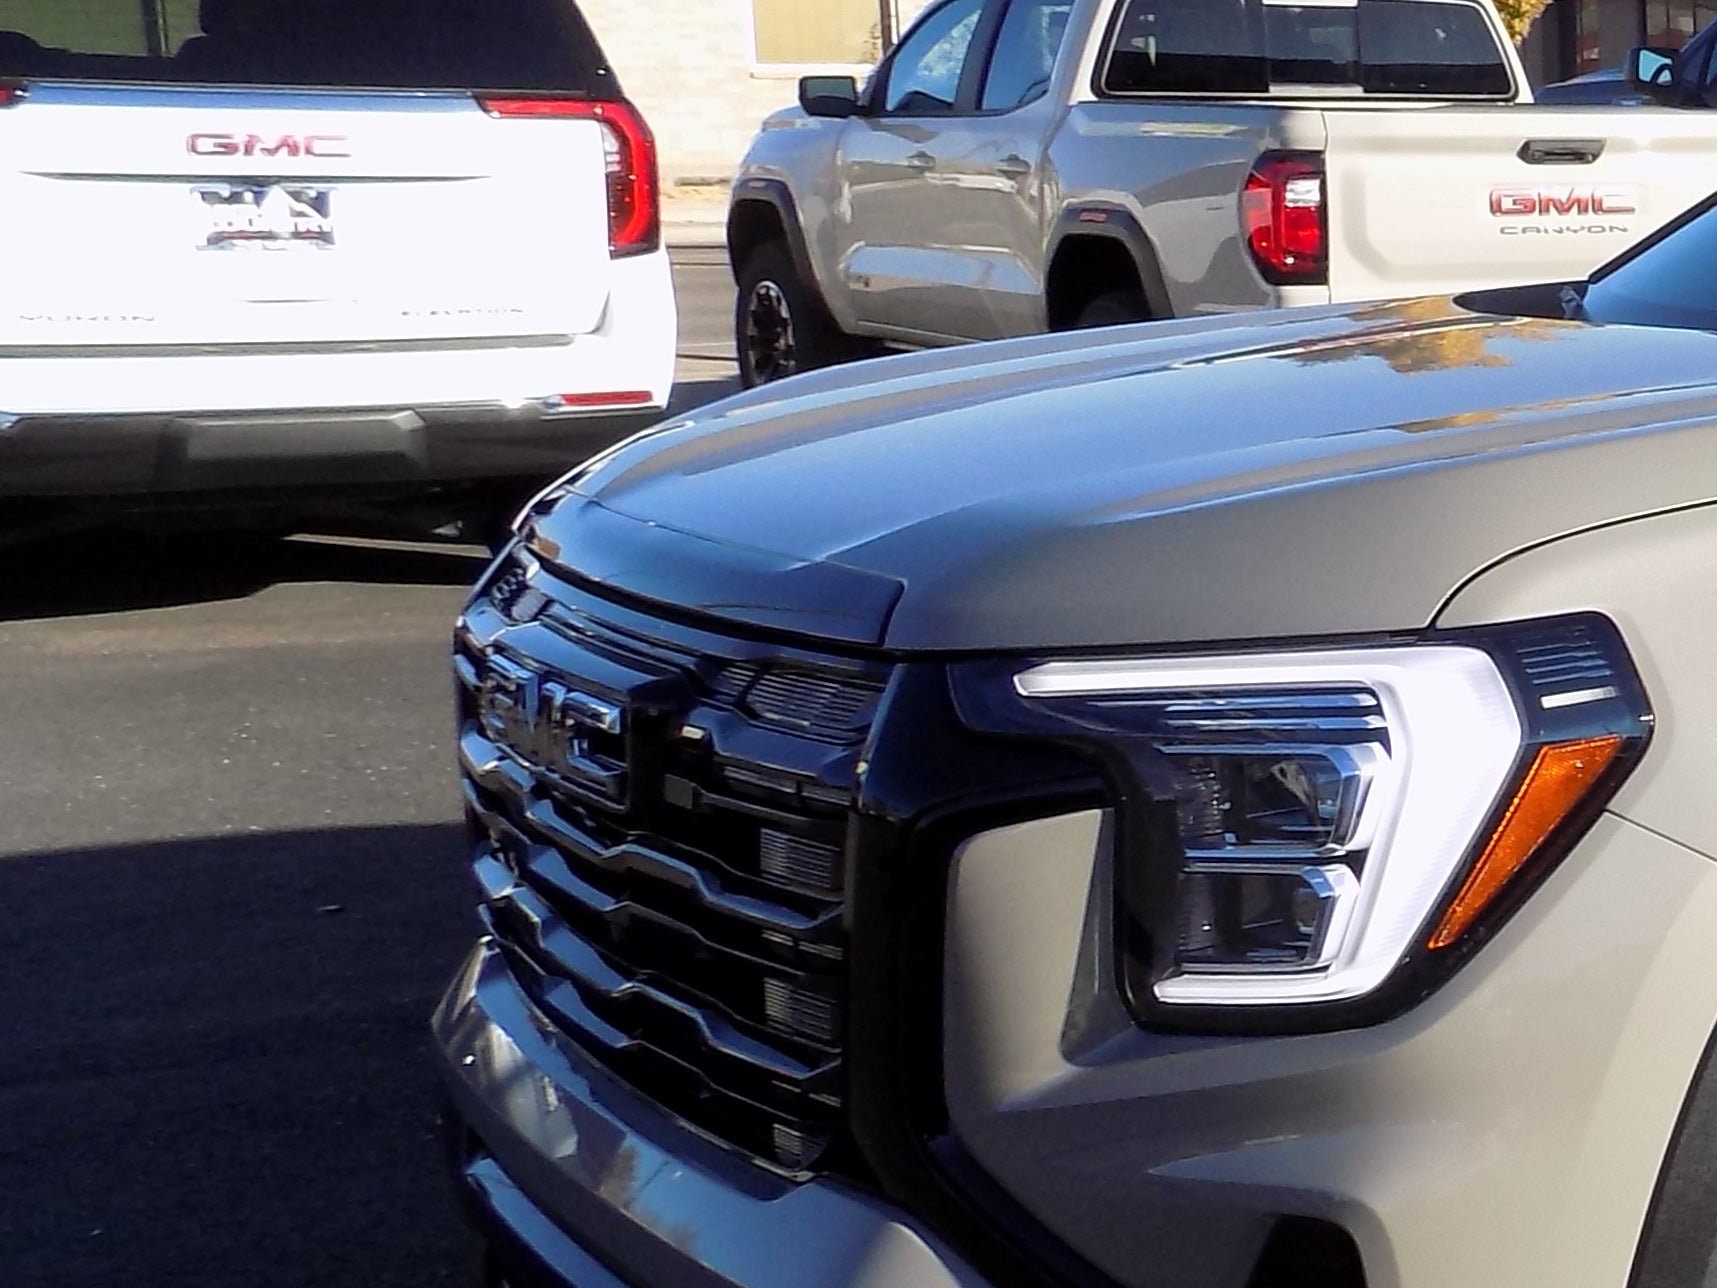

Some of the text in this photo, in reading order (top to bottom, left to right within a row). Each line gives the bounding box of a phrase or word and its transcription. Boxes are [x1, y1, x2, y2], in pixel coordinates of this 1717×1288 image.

[186, 133, 351, 157] GMC
[1489, 186, 1636, 217] GMC
[1499, 225, 1629, 235] CANYON
